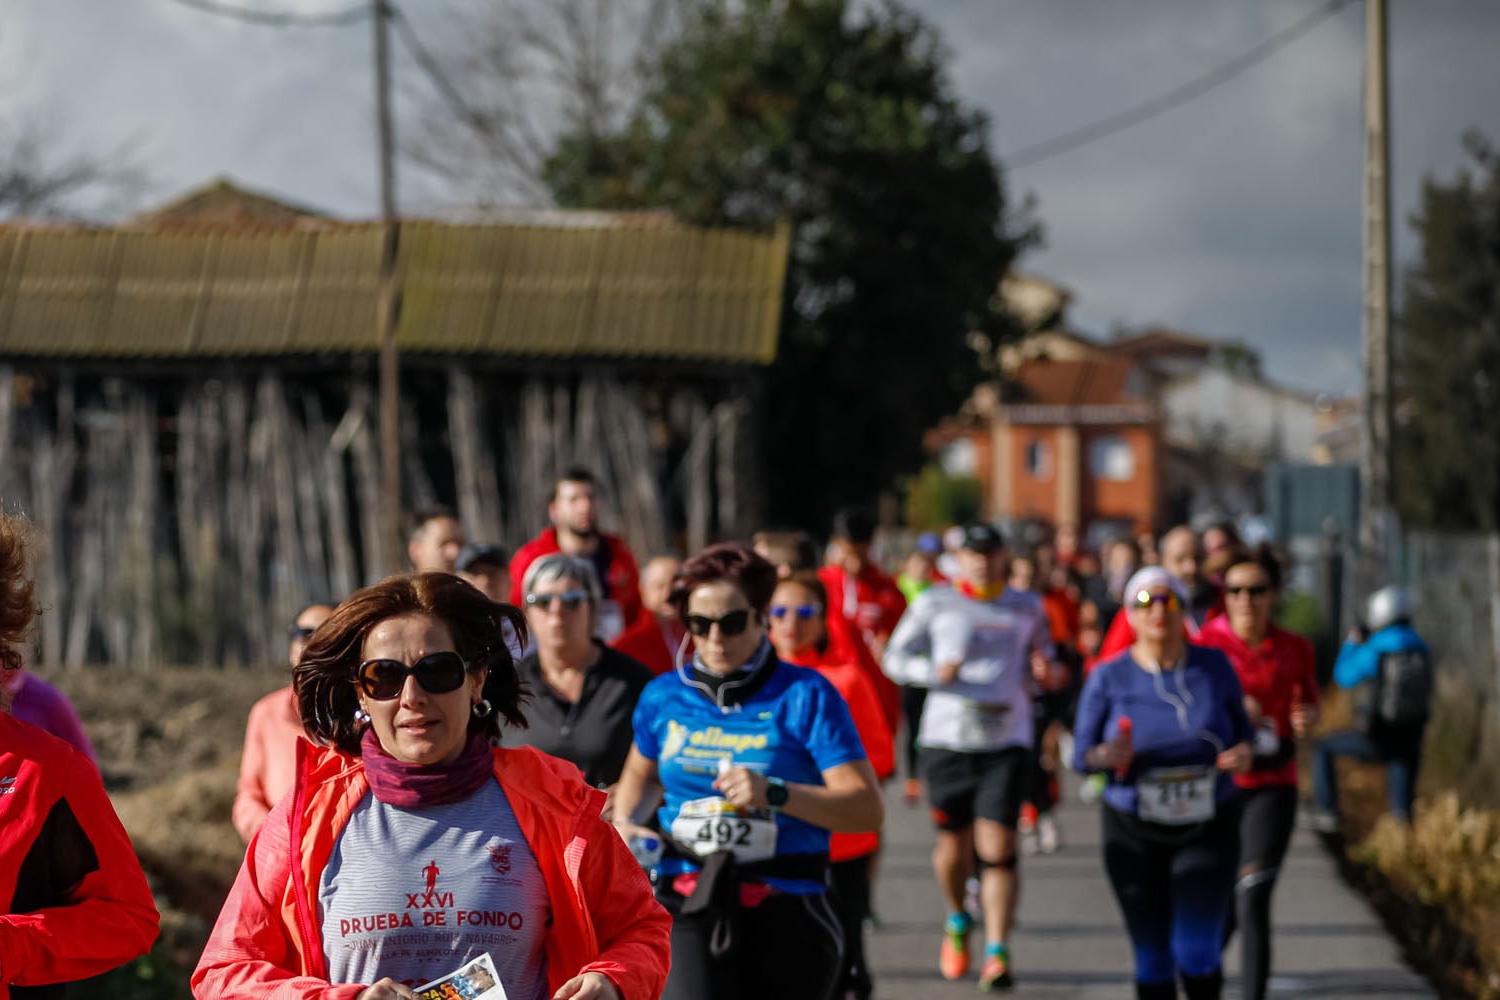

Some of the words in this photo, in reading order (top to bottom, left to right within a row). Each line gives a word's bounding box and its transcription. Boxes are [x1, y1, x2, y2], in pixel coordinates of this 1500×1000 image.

[690, 727, 768, 753] olimpo
[697, 821, 752, 846] 492
[406, 892, 454, 909] XXVI
[340, 912, 413, 937] PRUEBA
[423, 911, 446, 926] DE
[457, 911, 523, 931] FONDO
[383, 934, 429, 947] ANTONIO
